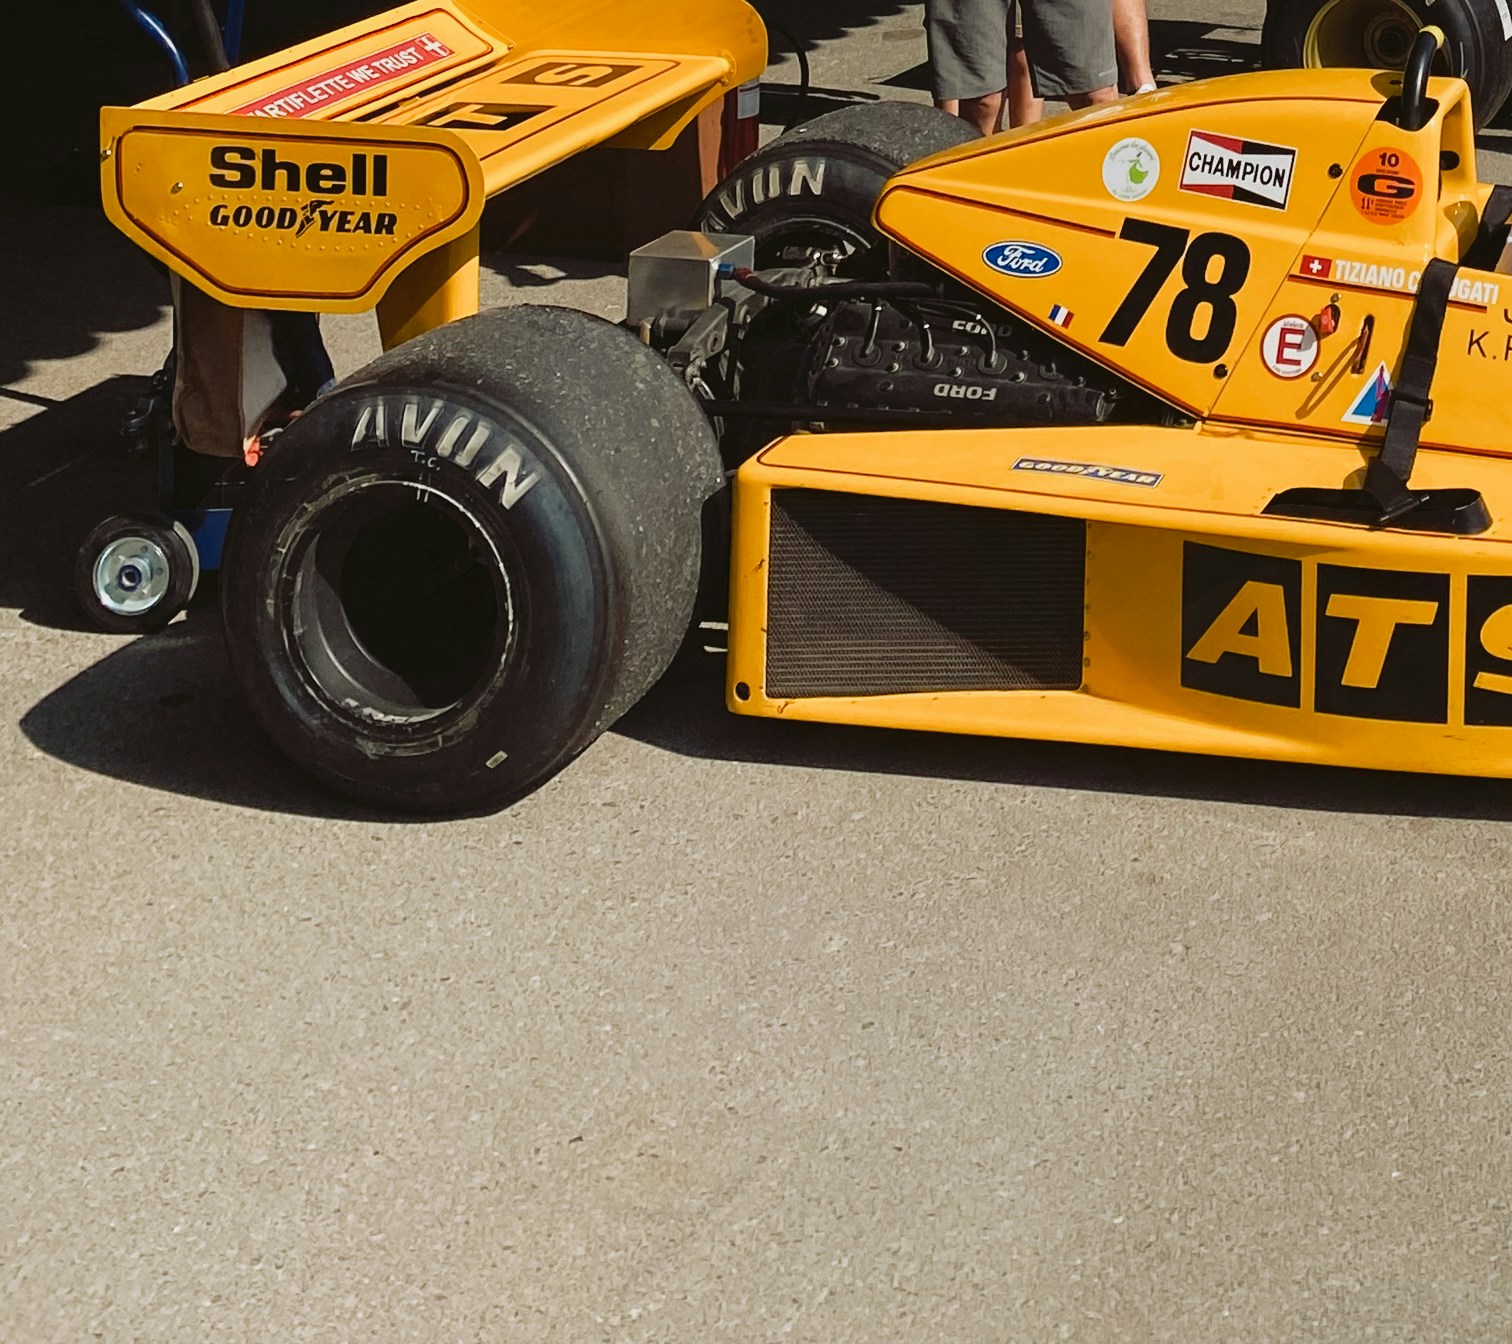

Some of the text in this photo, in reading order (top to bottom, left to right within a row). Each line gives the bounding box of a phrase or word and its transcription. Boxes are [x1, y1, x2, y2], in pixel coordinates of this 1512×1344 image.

[343, 62, 376, 92] WE
[371, 46, 423, 80] TRUST
[208, 145, 389, 198] Shell
[1188, 151, 1288, 189] CHAMPION
[1379, 152, 1400, 168] 10
[994, 246, 1052, 277] Ford
[1334, 259, 1500, 305] TIZIANO CUGATI
[1098, 216, 1251, 364] 78
[1275, 327, 1306, 367] E
[933, 382, 998, 401] FORD
[350, 396, 545, 511] AVON
